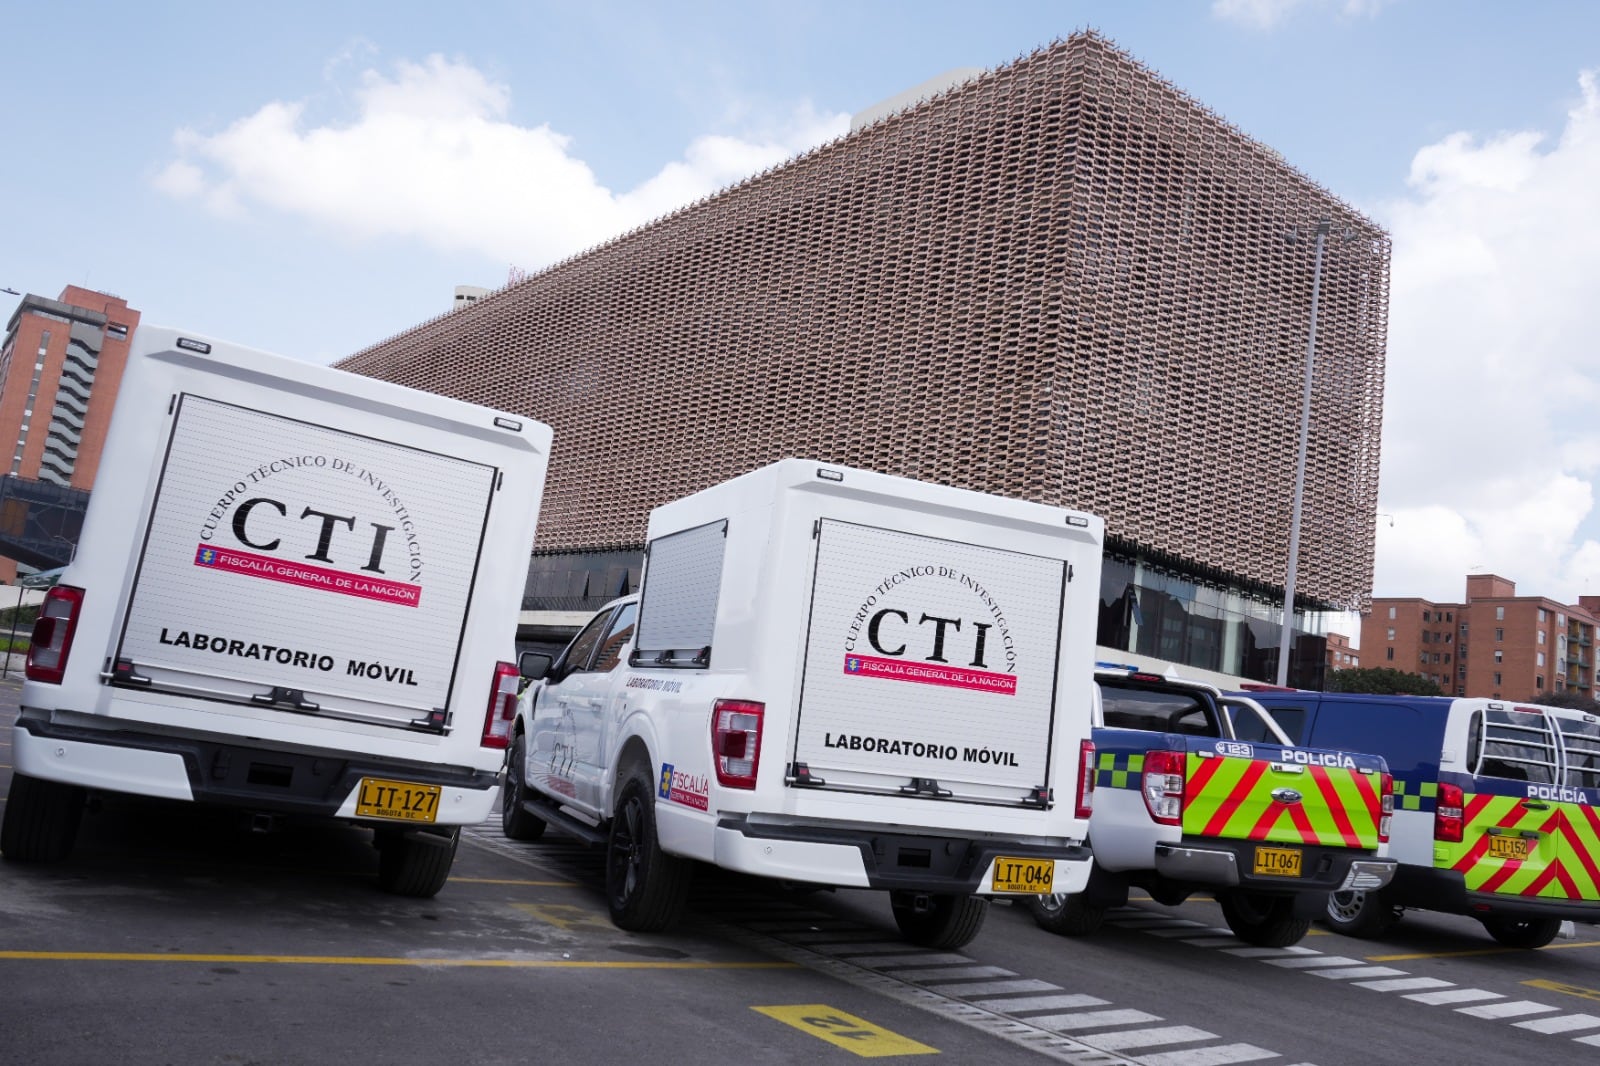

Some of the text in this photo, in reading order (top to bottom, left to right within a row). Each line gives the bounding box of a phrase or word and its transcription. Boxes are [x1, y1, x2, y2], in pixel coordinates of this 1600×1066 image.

[200, 456, 425, 582] CUERPO TÉCNICO DE INVESTIGACIÓN
[232, 497, 395, 574] CTI
[219, 555, 415, 600] FISCALÍA GENERAL DE LA NACIÓN
[845, 565, 1018, 672] CUERPO TÉCNICO DE INVESTIGACIÓN
[868, 608, 992, 668] CTI
[160, 627, 418, 686] LABORATORIO MÓVIL
[862, 661, 1014, 689] FISCALÍA GENERAL DE LA NACIÓN
[824, 732, 1019, 767] LABORATORIO MÓVIL
[1227, 744, 1250, 755] 123
[1281, 749, 1357, 769] POLICÍA
[671, 771, 709, 796] FISCALÍA
[1527, 785, 1589, 804] POLICÍA
